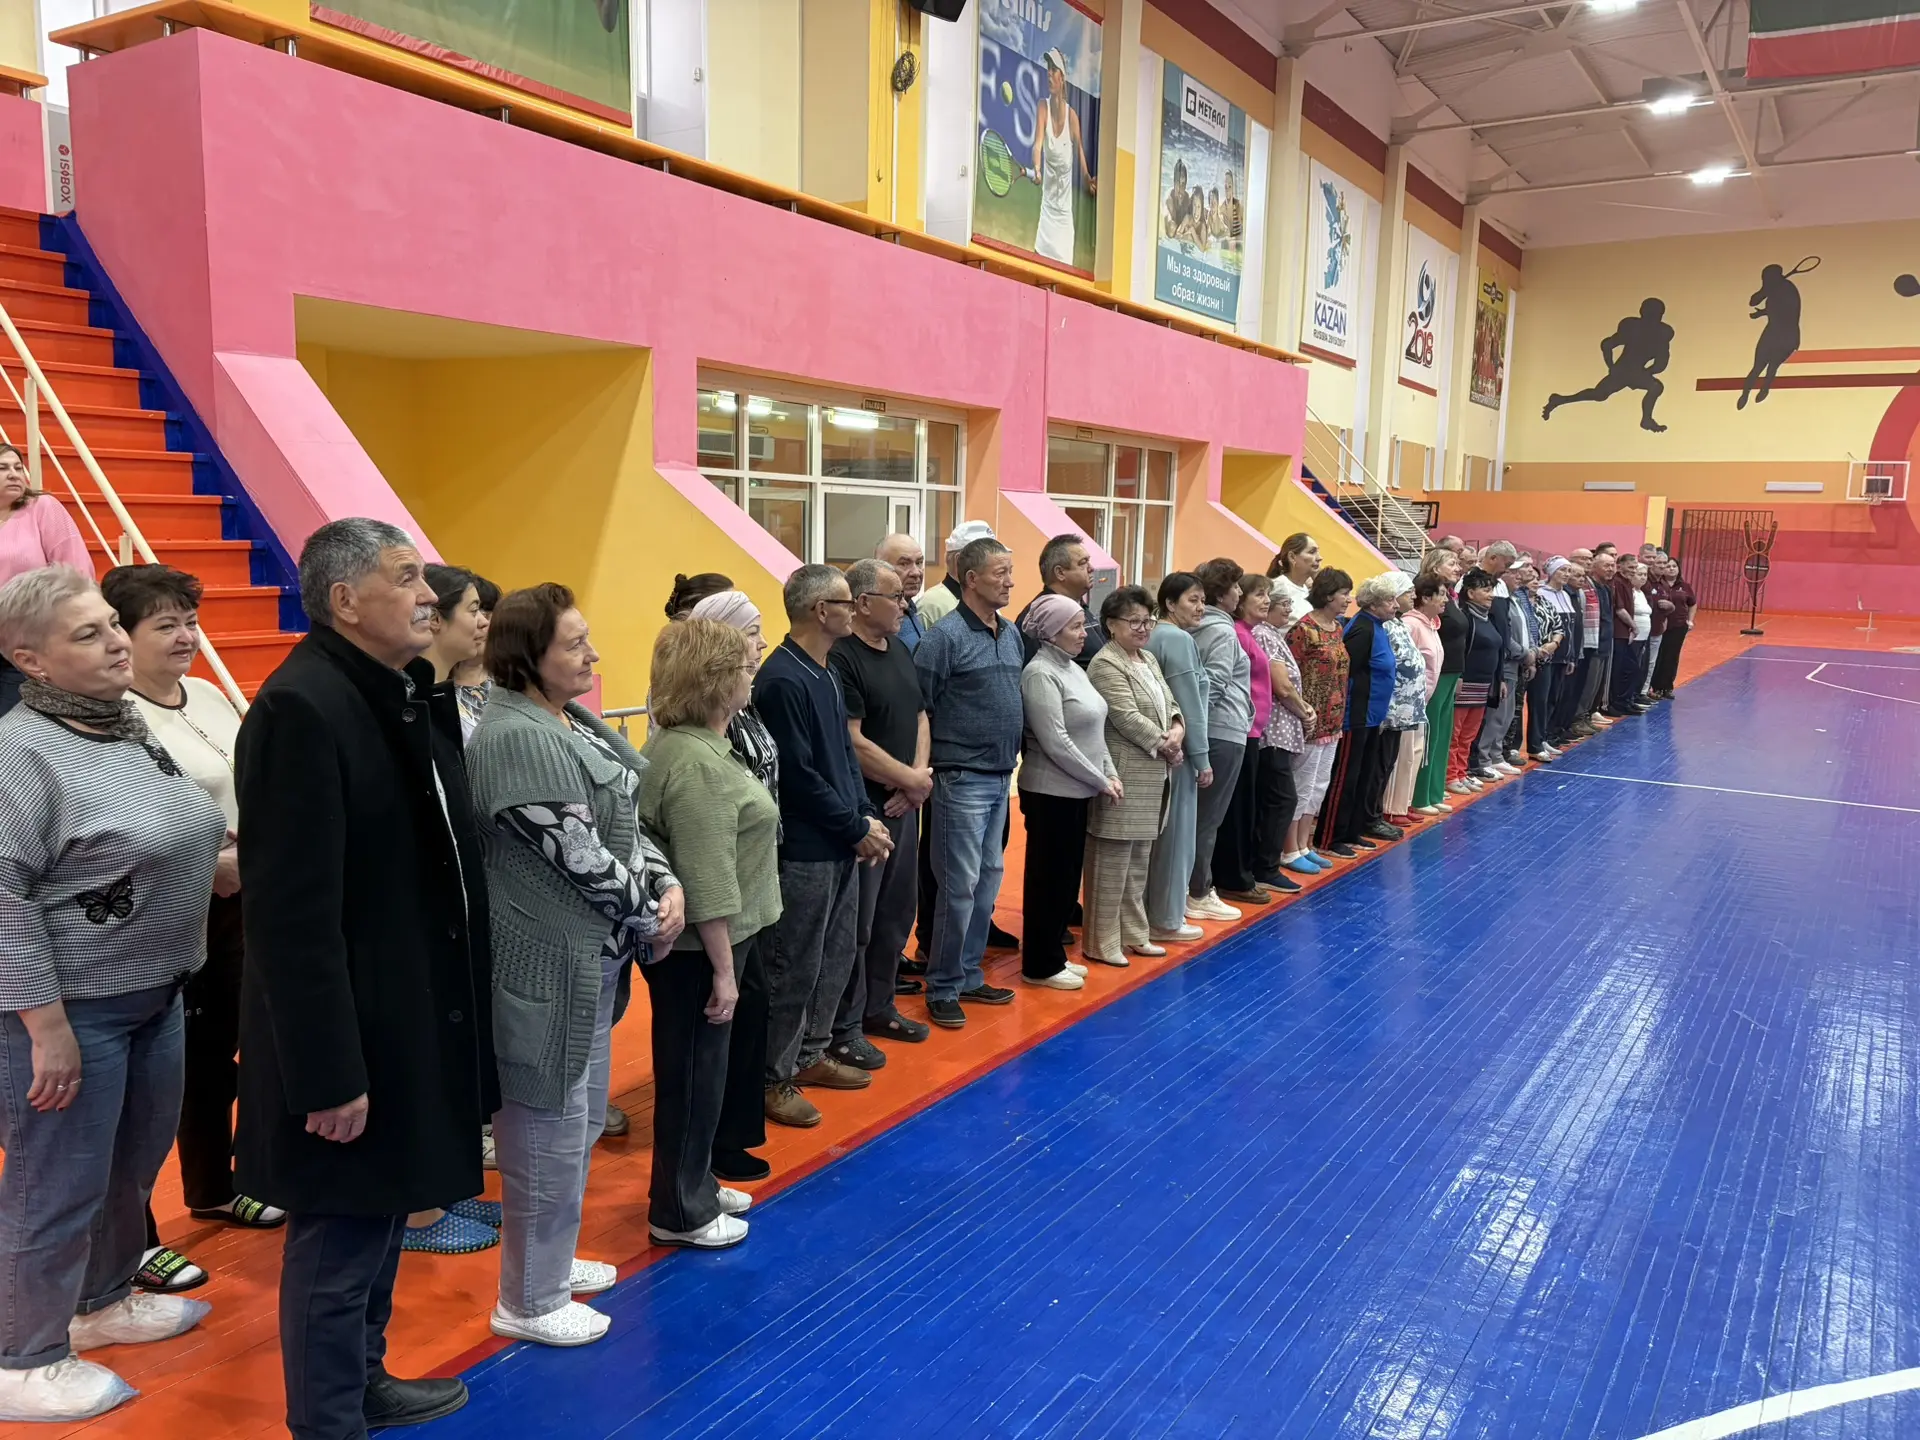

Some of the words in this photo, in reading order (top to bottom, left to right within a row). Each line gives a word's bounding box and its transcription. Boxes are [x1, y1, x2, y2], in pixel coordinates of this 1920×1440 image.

[59, 158, 71, 204] ISOBOX
[1166, 254, 1181, 275] Мы
[1182, 264, 1191, 278] за
[1192, 268, 1231, 293] здоровый
[1171, 282, 1195, 303] образ
[1196, 292, 1220, 311] жизни
[1314, 300, 1347, 336] KAZAN
[1405, 311, 1434, 369] 2018
